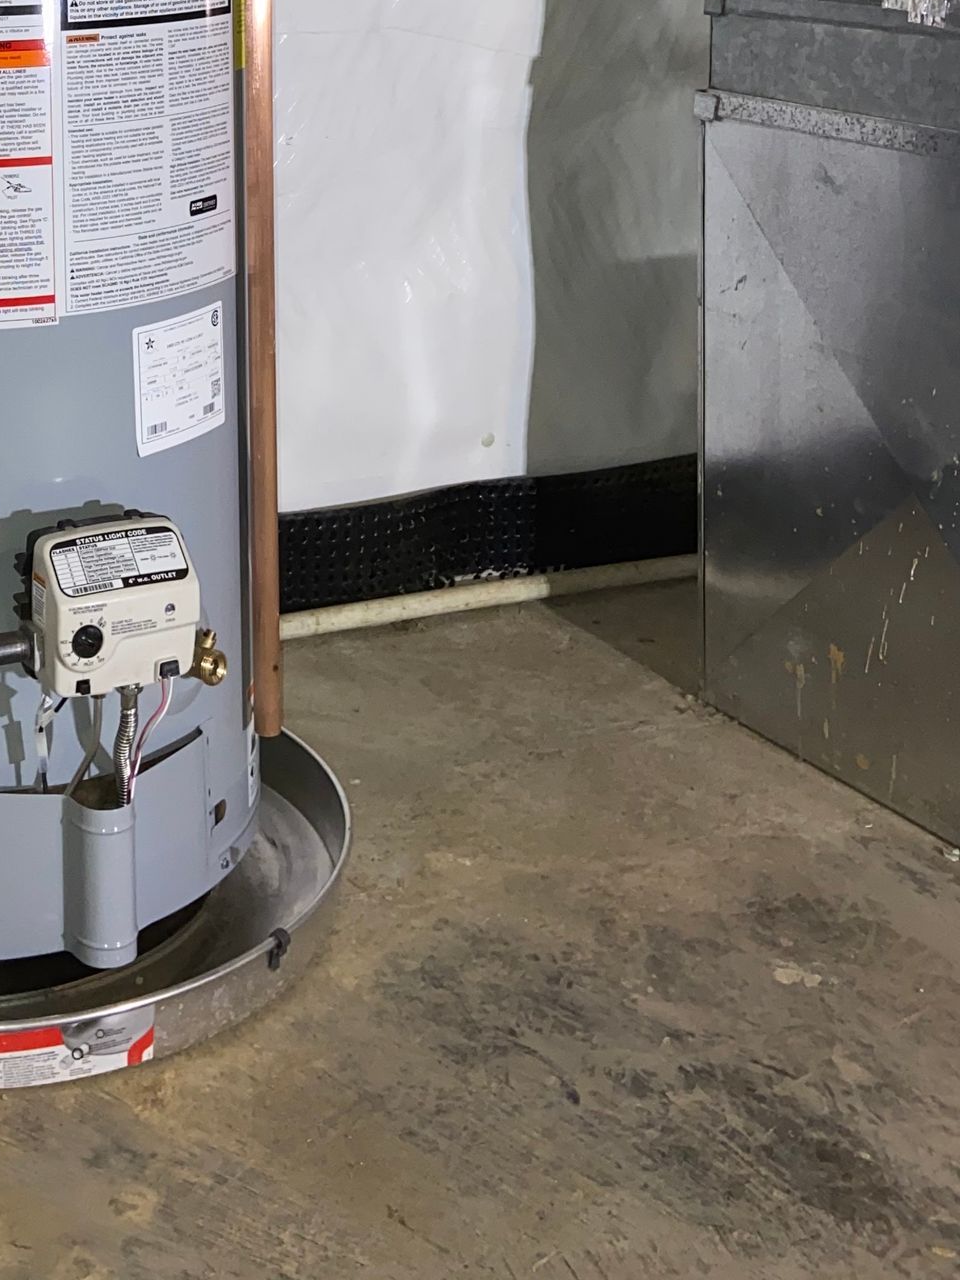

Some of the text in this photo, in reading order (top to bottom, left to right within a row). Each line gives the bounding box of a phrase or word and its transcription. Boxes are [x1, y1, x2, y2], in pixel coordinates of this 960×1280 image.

[76, 529, 147, 545] STATUS LIGHT CODE
[151, 572, 176, 580] OUTLET
